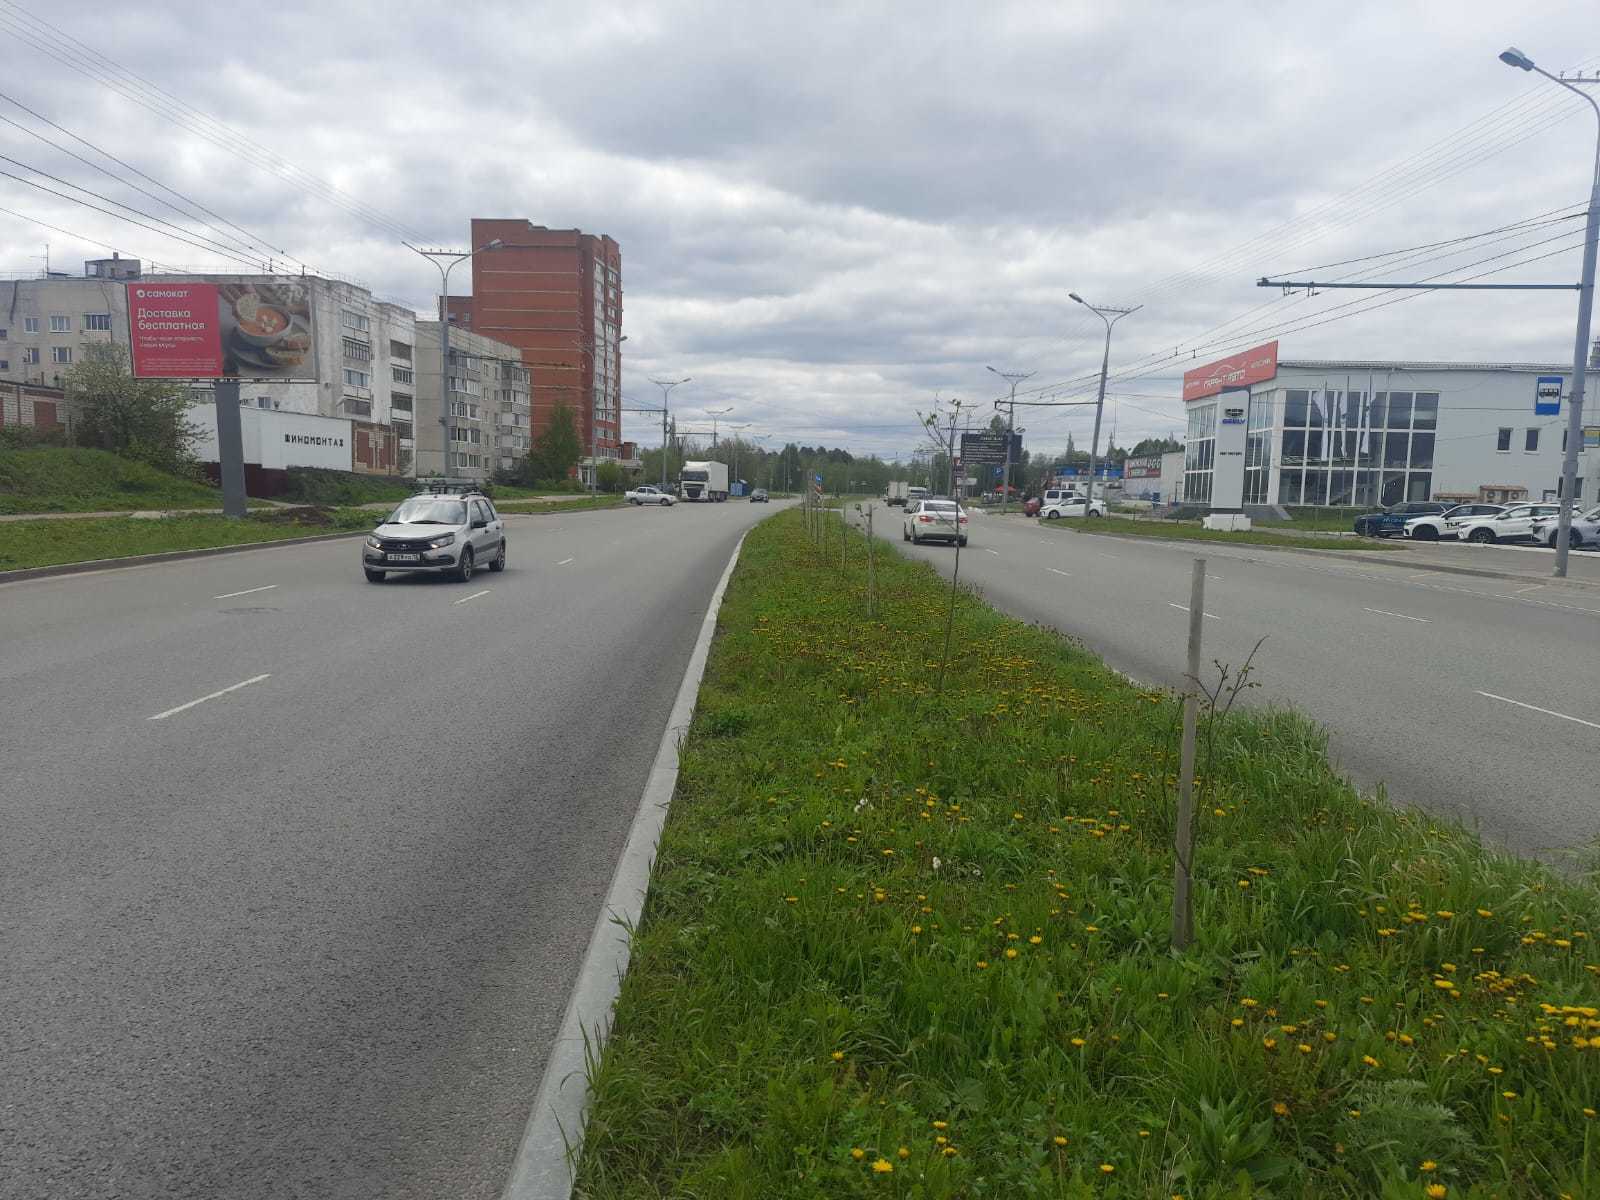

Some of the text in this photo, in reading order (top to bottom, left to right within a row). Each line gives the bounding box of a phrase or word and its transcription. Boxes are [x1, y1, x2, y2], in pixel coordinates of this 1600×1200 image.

[137, 308, 191, 319] Доставка
[138, 319, 205, 330] бесплатная
[284, 434, 344, 447] ШИНОМОНТАЖ
